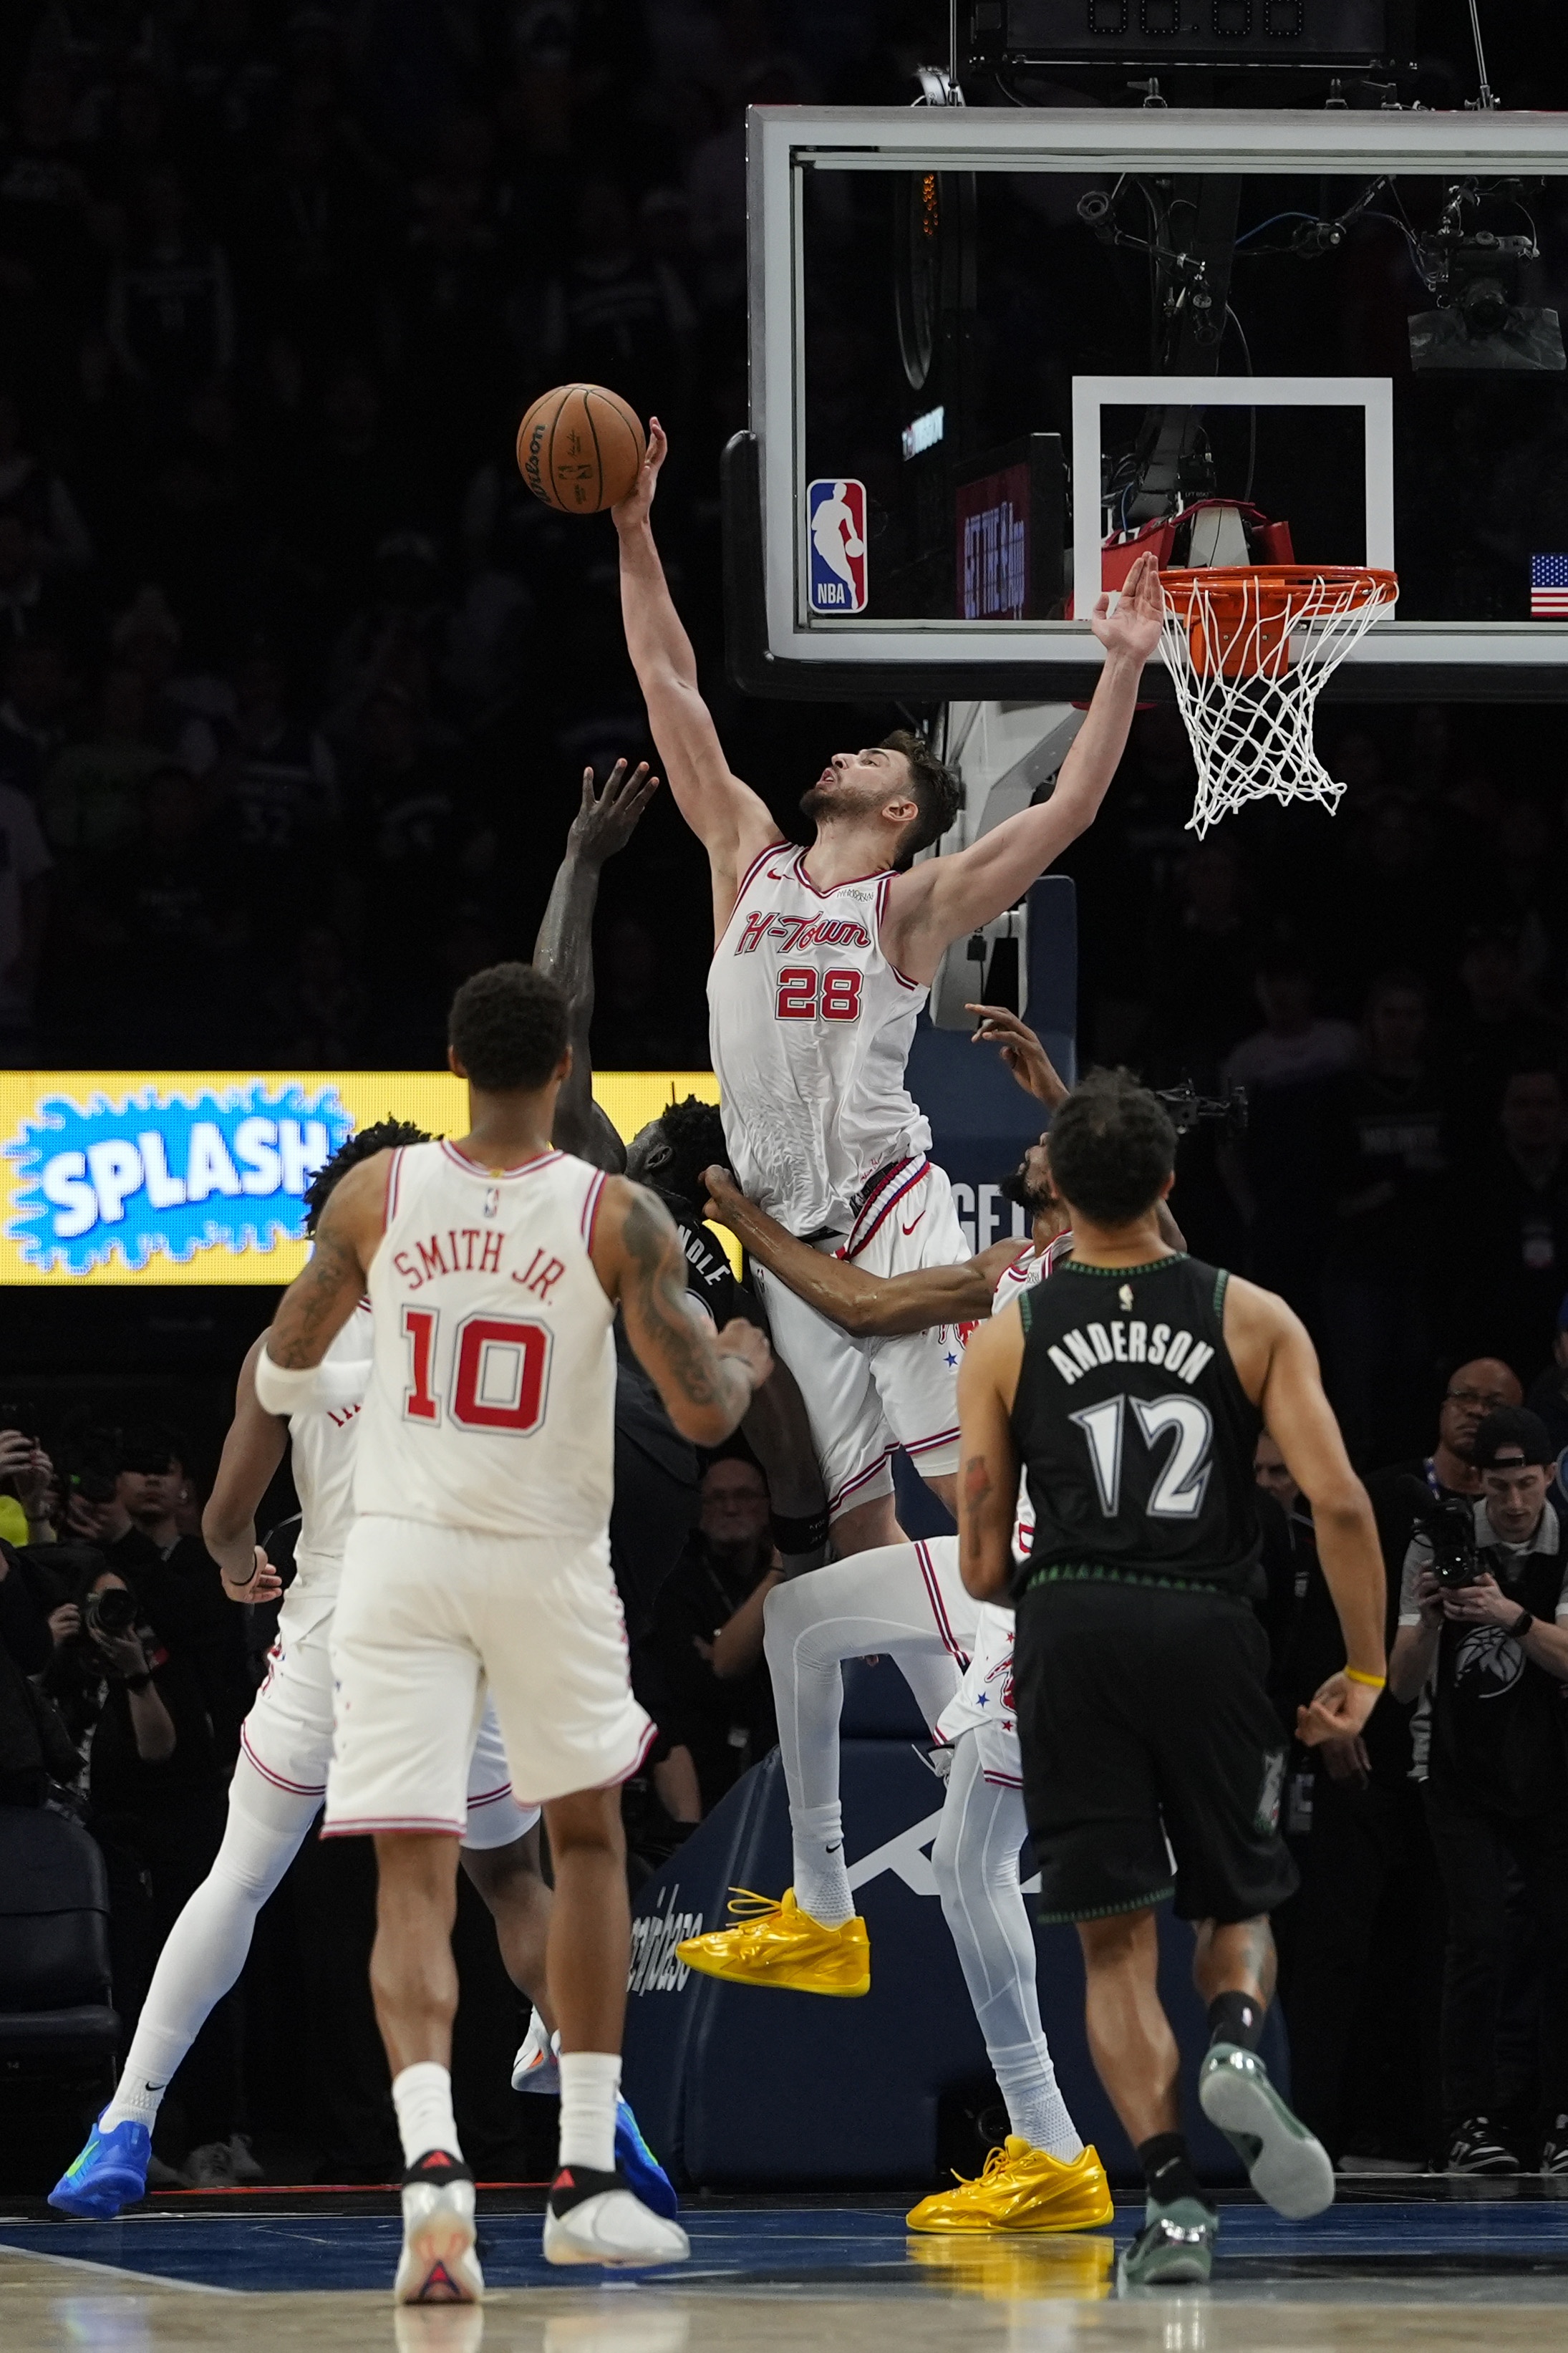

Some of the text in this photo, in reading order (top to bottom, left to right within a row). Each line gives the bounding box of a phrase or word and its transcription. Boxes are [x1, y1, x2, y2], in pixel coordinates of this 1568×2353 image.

[525, 425, 551, 503] Wilson
[818, 583, 846, 604] NBA
[734, 911, 871, 956] H-Town
[775, 965, 864, 1023] 28
[42, 1116, 330, 1238] SPLASH
[394, 1229, 566, 1306] SMITH JR.
[400, 1303, 555, 1439] 10
[1047, 1320, 1215, 1386] ANDERSON
[1068, 1393, 1215, 1519] 12
